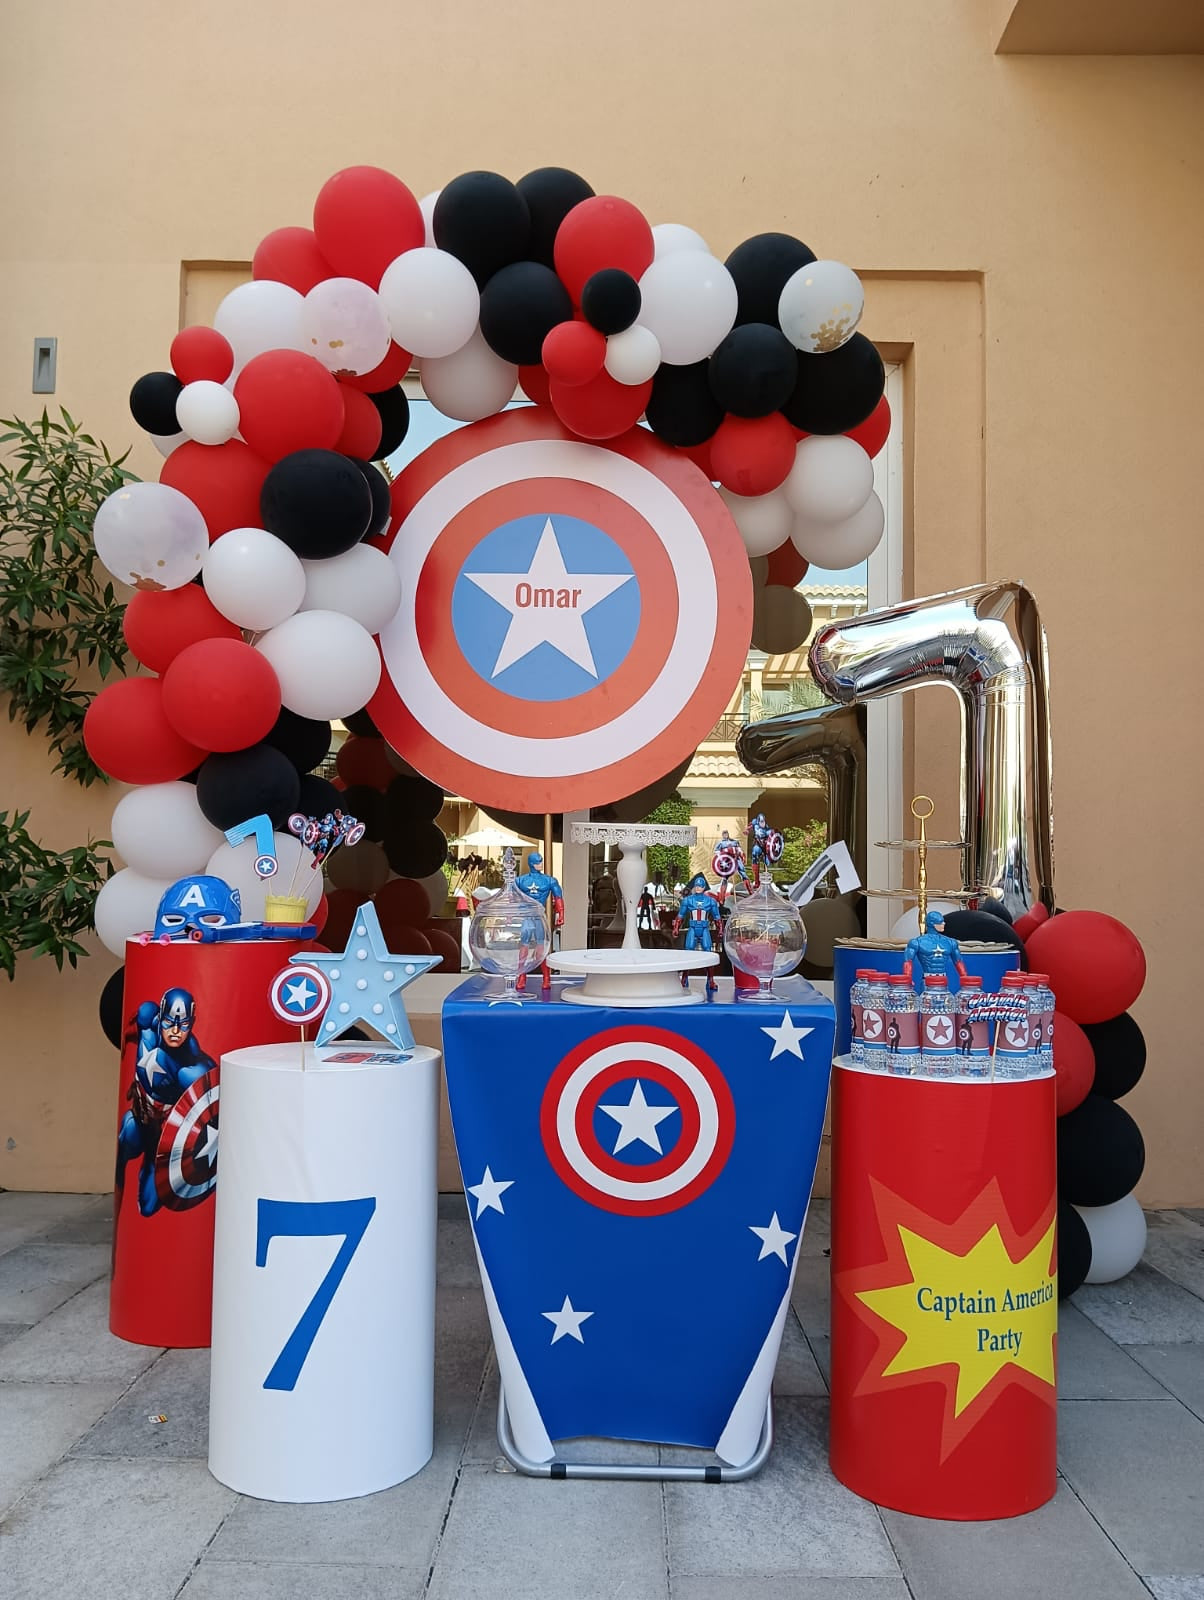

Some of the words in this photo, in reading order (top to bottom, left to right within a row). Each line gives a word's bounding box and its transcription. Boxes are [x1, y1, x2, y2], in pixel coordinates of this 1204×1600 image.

[515, 582, 582, 609] Omar
[179, 884, 207, 908] A
[968, 993, 1030, 1009] CAPTAIN
[967, 1007, 1028, 1023] AMERICA
[255, 1196, 377, 1392] 7
[916, 1287, 997, 1321] Captain
[1001, 1280, 1054, 1313] America
[976, 1328, 1023, 1357] Party
